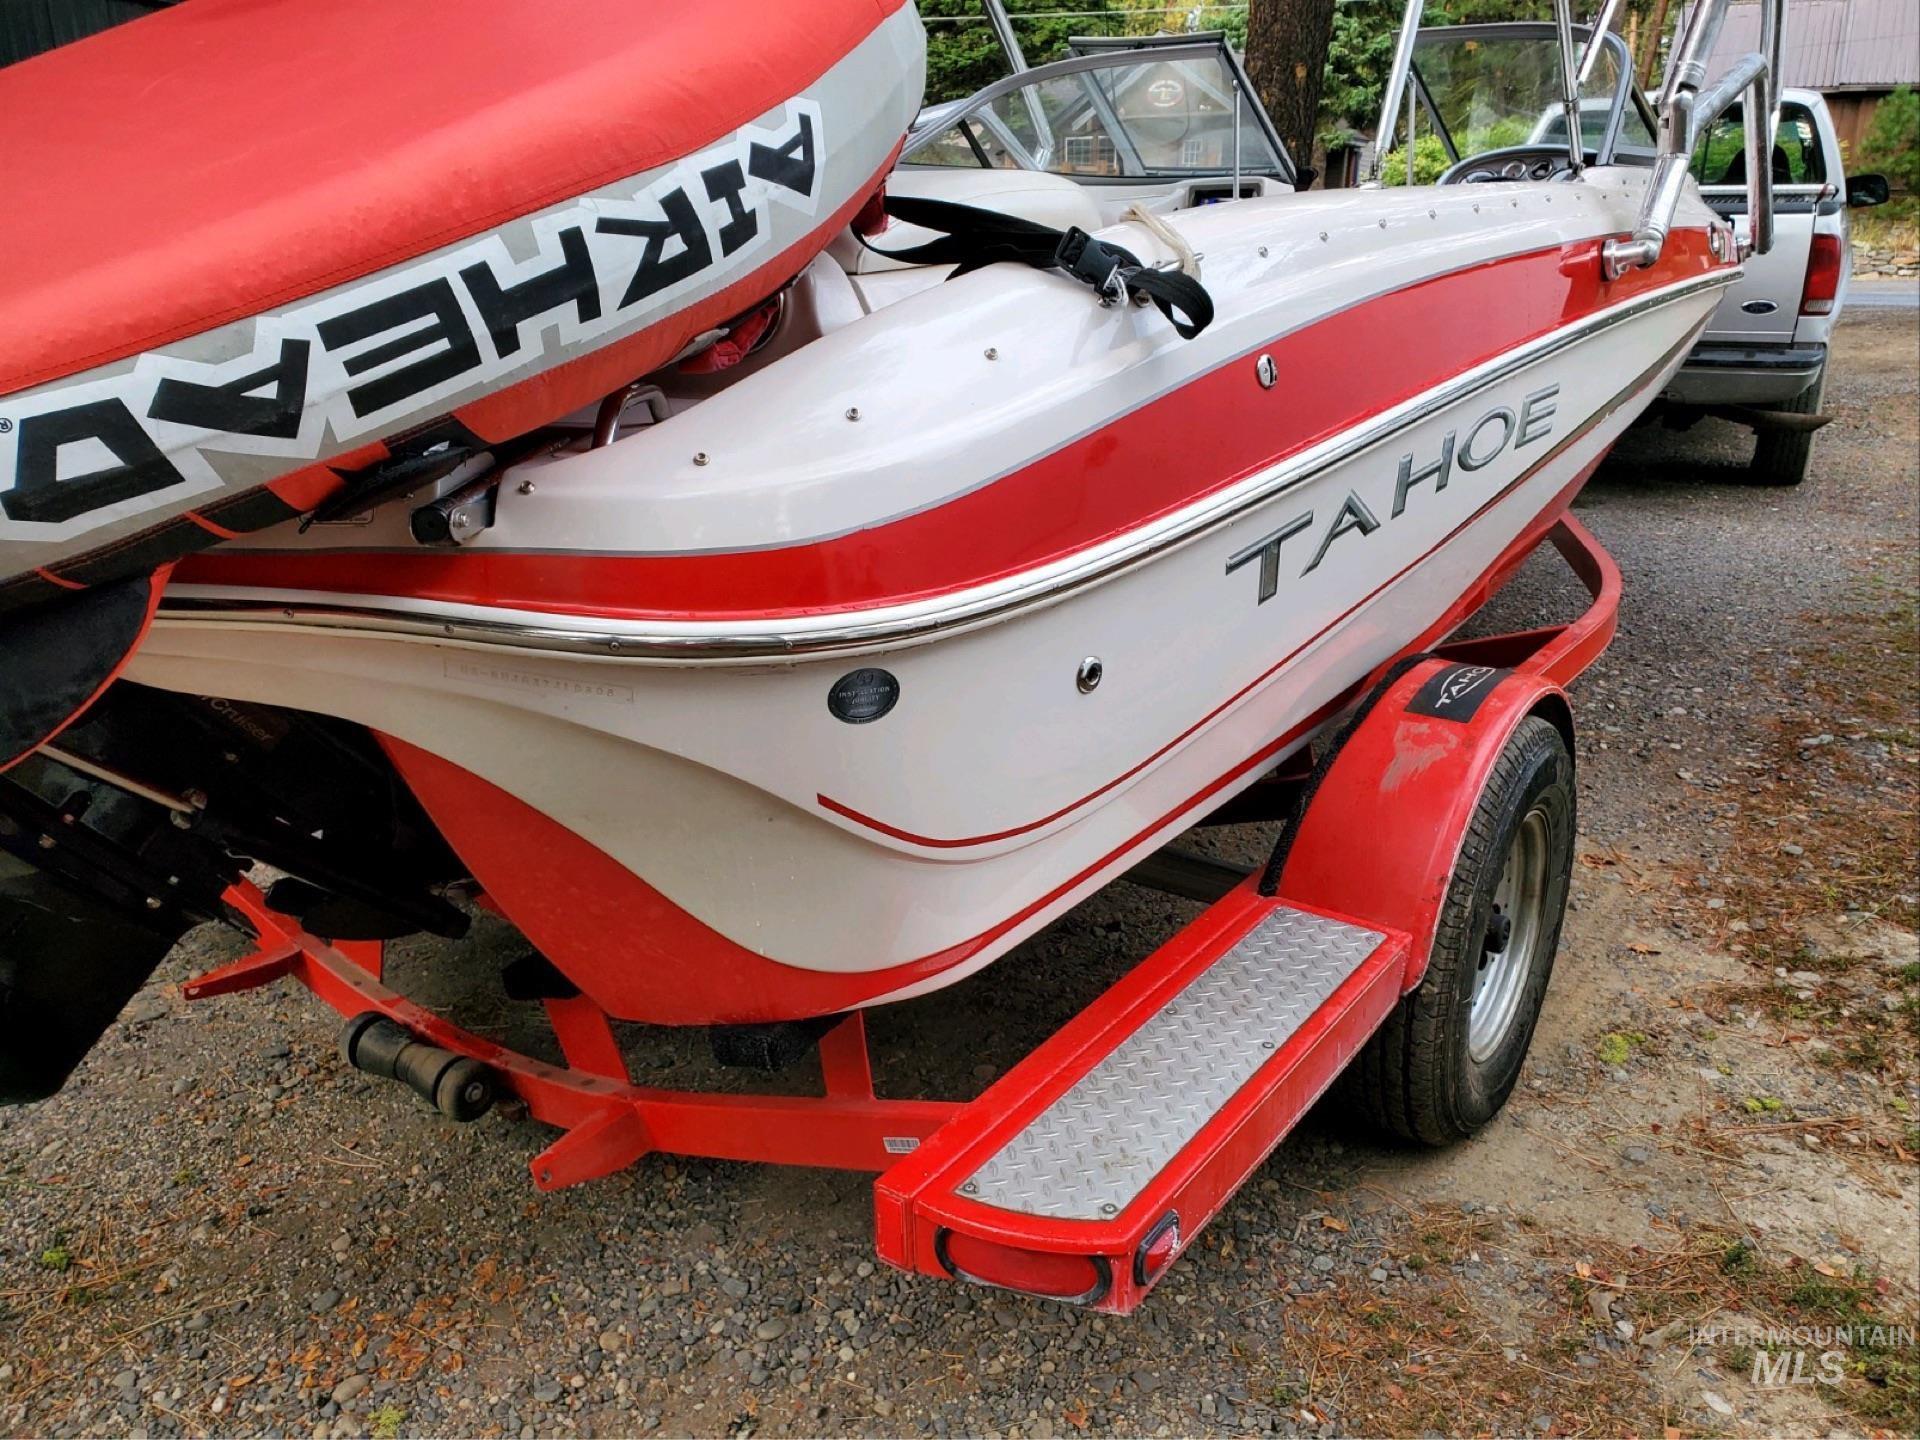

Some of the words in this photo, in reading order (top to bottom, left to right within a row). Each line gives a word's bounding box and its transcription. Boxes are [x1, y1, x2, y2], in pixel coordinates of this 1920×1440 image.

[1226, 382, 1560, 606] TAHOE
[839, 686, 890, 700] INSTATION
[1435, 666, 1488, 709] TAHO
